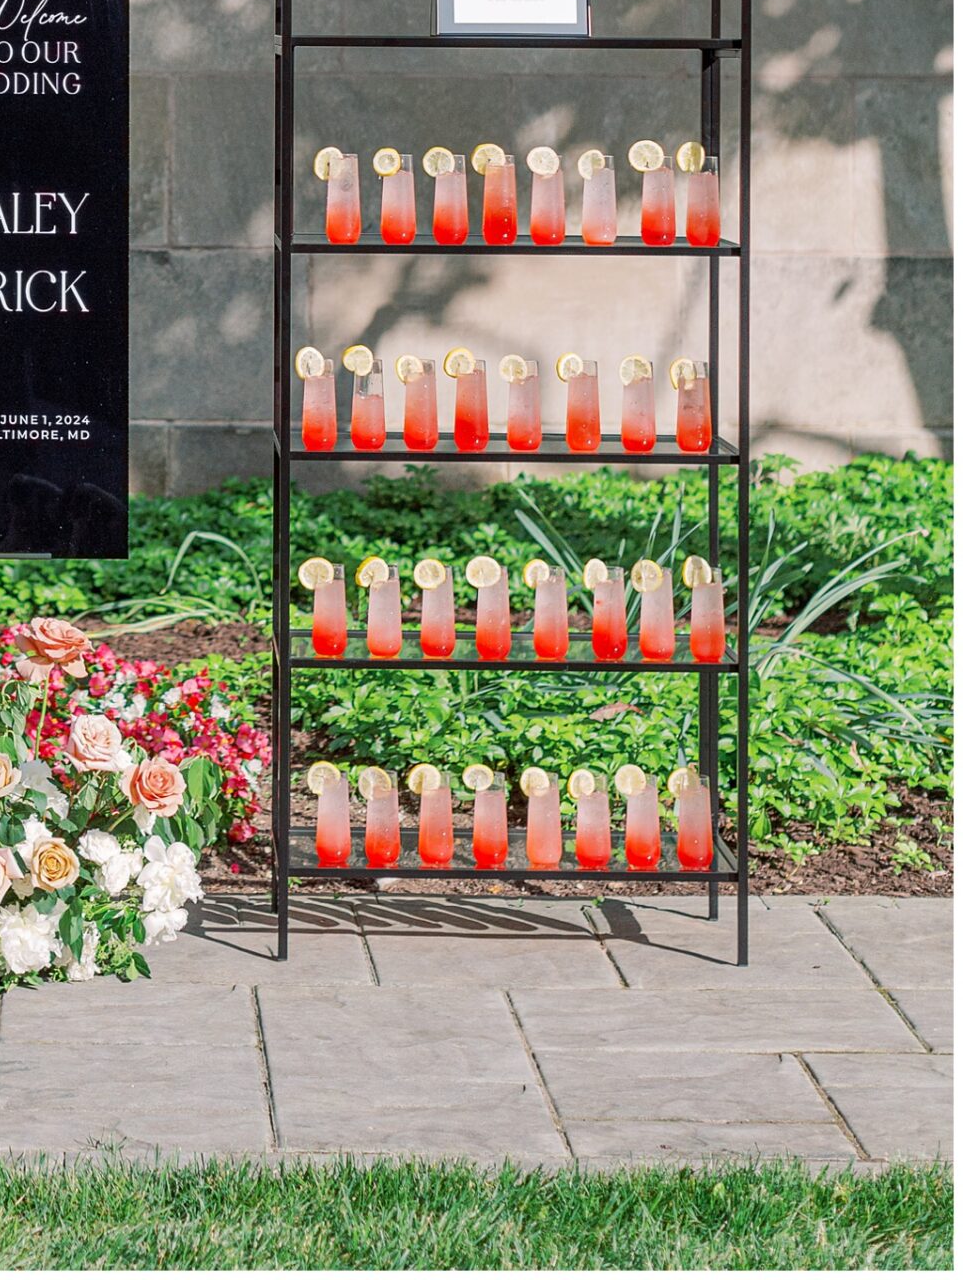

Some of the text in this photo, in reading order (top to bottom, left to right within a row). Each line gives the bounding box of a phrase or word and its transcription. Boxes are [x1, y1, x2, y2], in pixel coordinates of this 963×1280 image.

[21, 41, 82, 64] OUR
[0, 414, 90, 427] JUNE 1, 2024
[68, 429, 90, 440] MD
